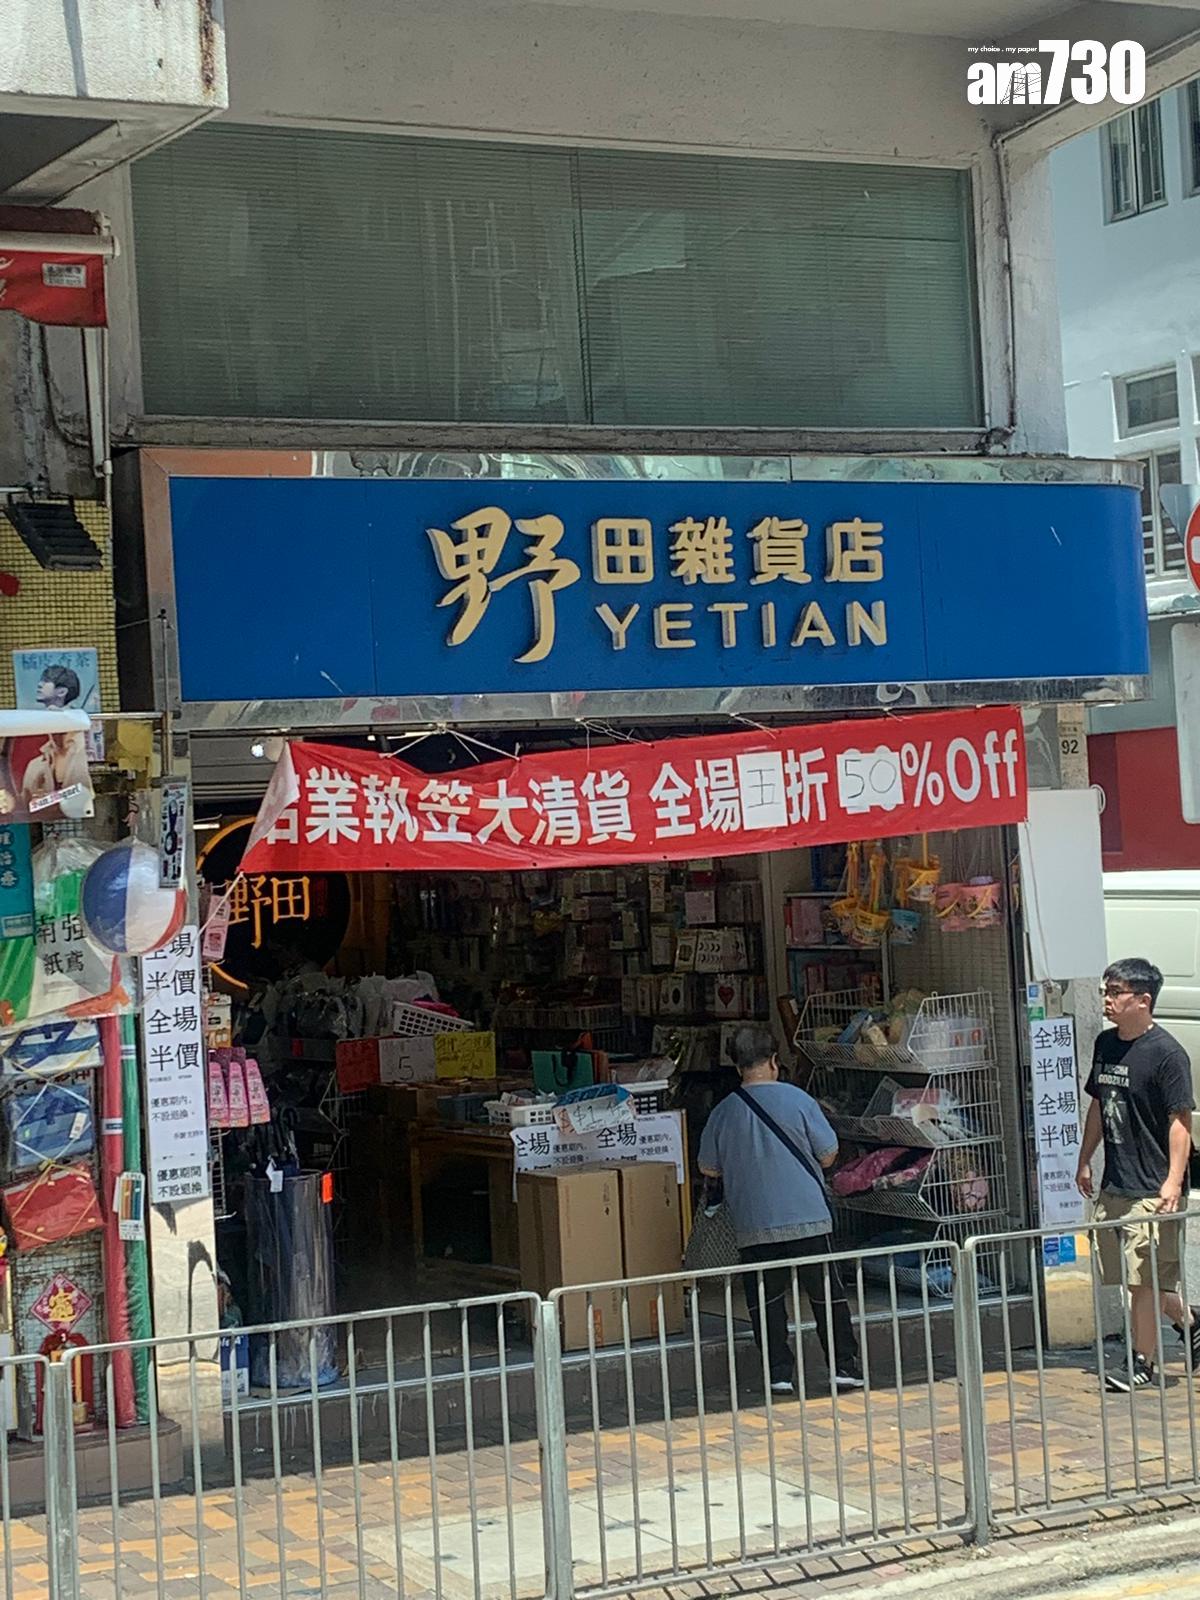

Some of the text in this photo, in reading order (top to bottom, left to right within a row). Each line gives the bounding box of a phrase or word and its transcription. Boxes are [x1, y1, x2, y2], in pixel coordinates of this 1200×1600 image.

[426, 506, 884, 663] 野田雜貨店
[595, 600, 887, 650] YETIAN
[1061, 739, 1080, 756] 92
[224, 875, 310, 949] 野田
[145, 968, 197, 998] 半價
[146, 1005, 199, 1035] 全場
[1033, 1024, 1072, 1050] 全場
[148, 1041, 200, 1072] 半價
[1036, 1055, 1075, 1082] 半價
[1037, 1090, 1077, 1117] 全場
[596, 1122, 638, 1149] 全場
[1040, 1123, 1080, 1149] 半價
